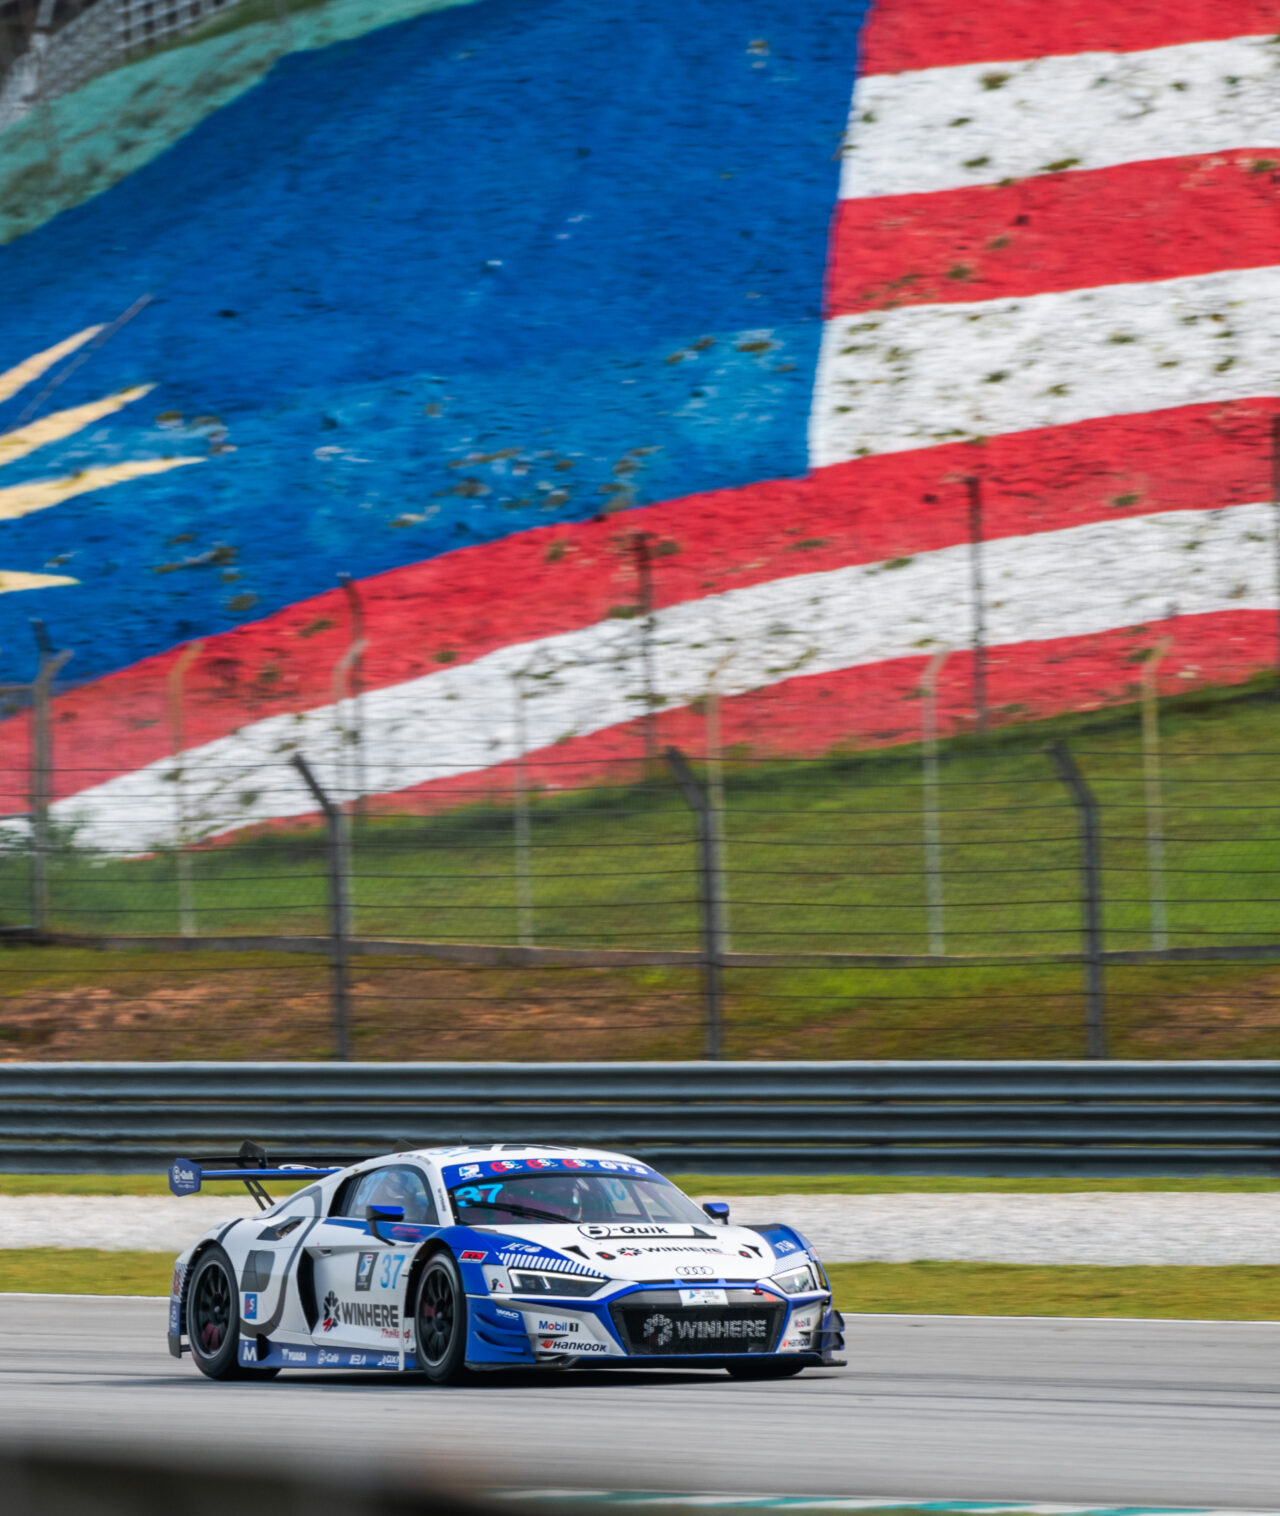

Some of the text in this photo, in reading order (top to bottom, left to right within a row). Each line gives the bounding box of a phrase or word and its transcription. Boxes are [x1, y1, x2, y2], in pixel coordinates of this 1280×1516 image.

[456, 1184, 503, 1207] 37
[577, 1223, 669, 1240] B-Quik
[380, 1254, 405, 1289] 37
[341, 1302, 399, 1328] WINHERE
[539, 1320, 567, 1332] Mobil
[677, 1319, 767, 1338] WINHERE
